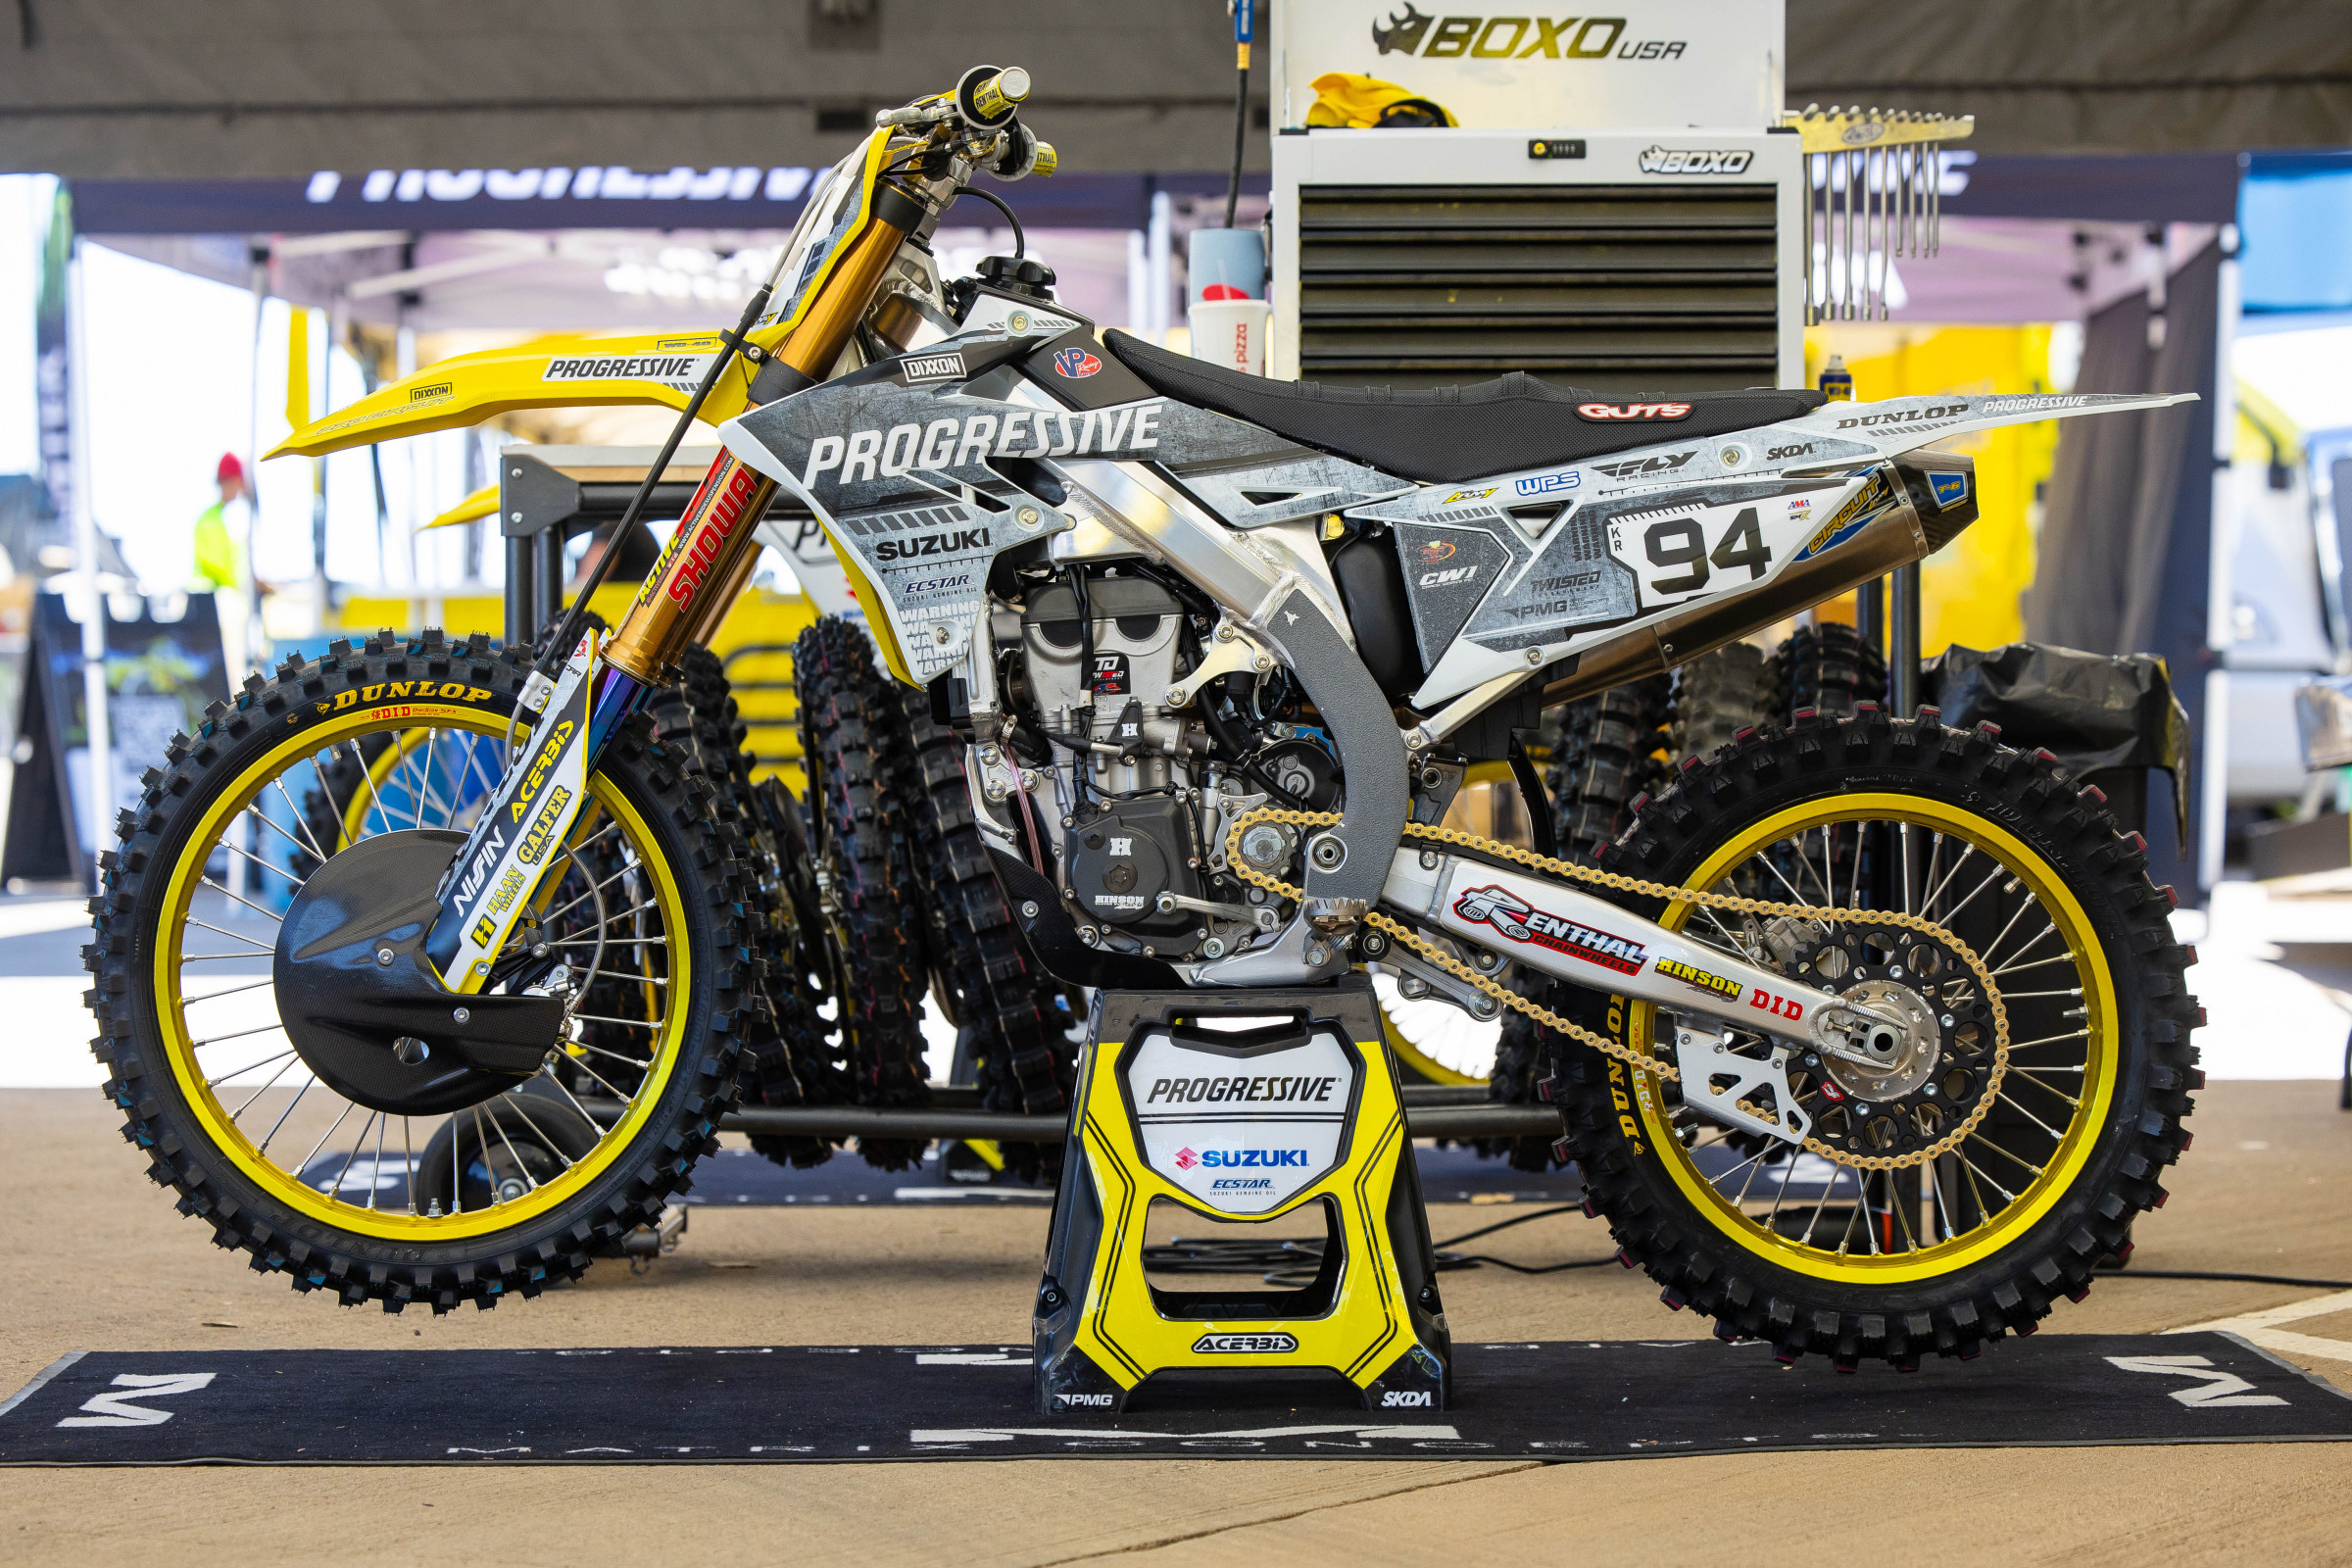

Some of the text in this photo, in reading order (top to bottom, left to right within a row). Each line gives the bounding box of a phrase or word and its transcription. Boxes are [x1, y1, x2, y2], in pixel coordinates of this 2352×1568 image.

[1421, 17, 1688, 60] BOXO USA
[1661, 150, 1753, 173] BOXO
[1234, 323, 1249, 364] pizza
[546, 358, 696, 378] PROGRESSIVE
[908, 357, 960, 377] DIXXON
[1054, 347, 1086, 378] VP
[414, 384, 449, 401] DIXXON
[1577, 402, 1691, 419] GUTS
[1837, 395, 2088, 430] DUNLOP PROGRESSIVE
[803, 403, 1164, 491] PROGRESSIVE
[1766, 443, 1813, 461] SKDA
[1591, 450, 1699, 477] FLY
[1515, 470, 1582, 497] WPS
[1787, 499, 1811, 511] AMA
[1808, 476, 1880, 555] CIRCUIT
[667, 466, 759, 613] SHOWA
[875, 527, 992, 562] SUZUKI
[1643, 507, 1773, 596] 94
[905, 573, 970, 594] ECSTAR
[1531, 569, 1602, 594] TWISTED
[900, 600, 981, 623] WARNING
[1520, 600, 1568, 619] PMG
[333, 680, 493, 712] DUNLOP
[381, 706, 411, 720] D.I.D
[511, 719, 575, 824] ACERBIS
[518, 786, 571, 864] GALFER
[531, 834, 556, 866] USA
[453, 824, 507, 918] NISSIN
[486, 863, 520, 915] HAAN
[499, 875, 526, 912] WHEELS
[1095, 895, 1145, 905] HINSON
[1458, 886, 1644, 965] RENTHAL
[1533, 934, 1638, 974] CHAINWHEELS
[1656, 957, 1743, 998] HINSON
[1749, 988, 1804, 1021] D.I.D
[1607, 994, 1642, 1140] DUNO
[1147, 1077, 1337, 1104] PROGRESSIVE
[1201, 1149, 1309, 1167] SUZUKI
[1212, 1178, 1271, 1189] ECSTAR
[1194, 1336, 1297, 1351] ACERBIS
[1070, 1394, 1113, 1406] PMG
[1381, 1391, 1432, 1407] SKDA
